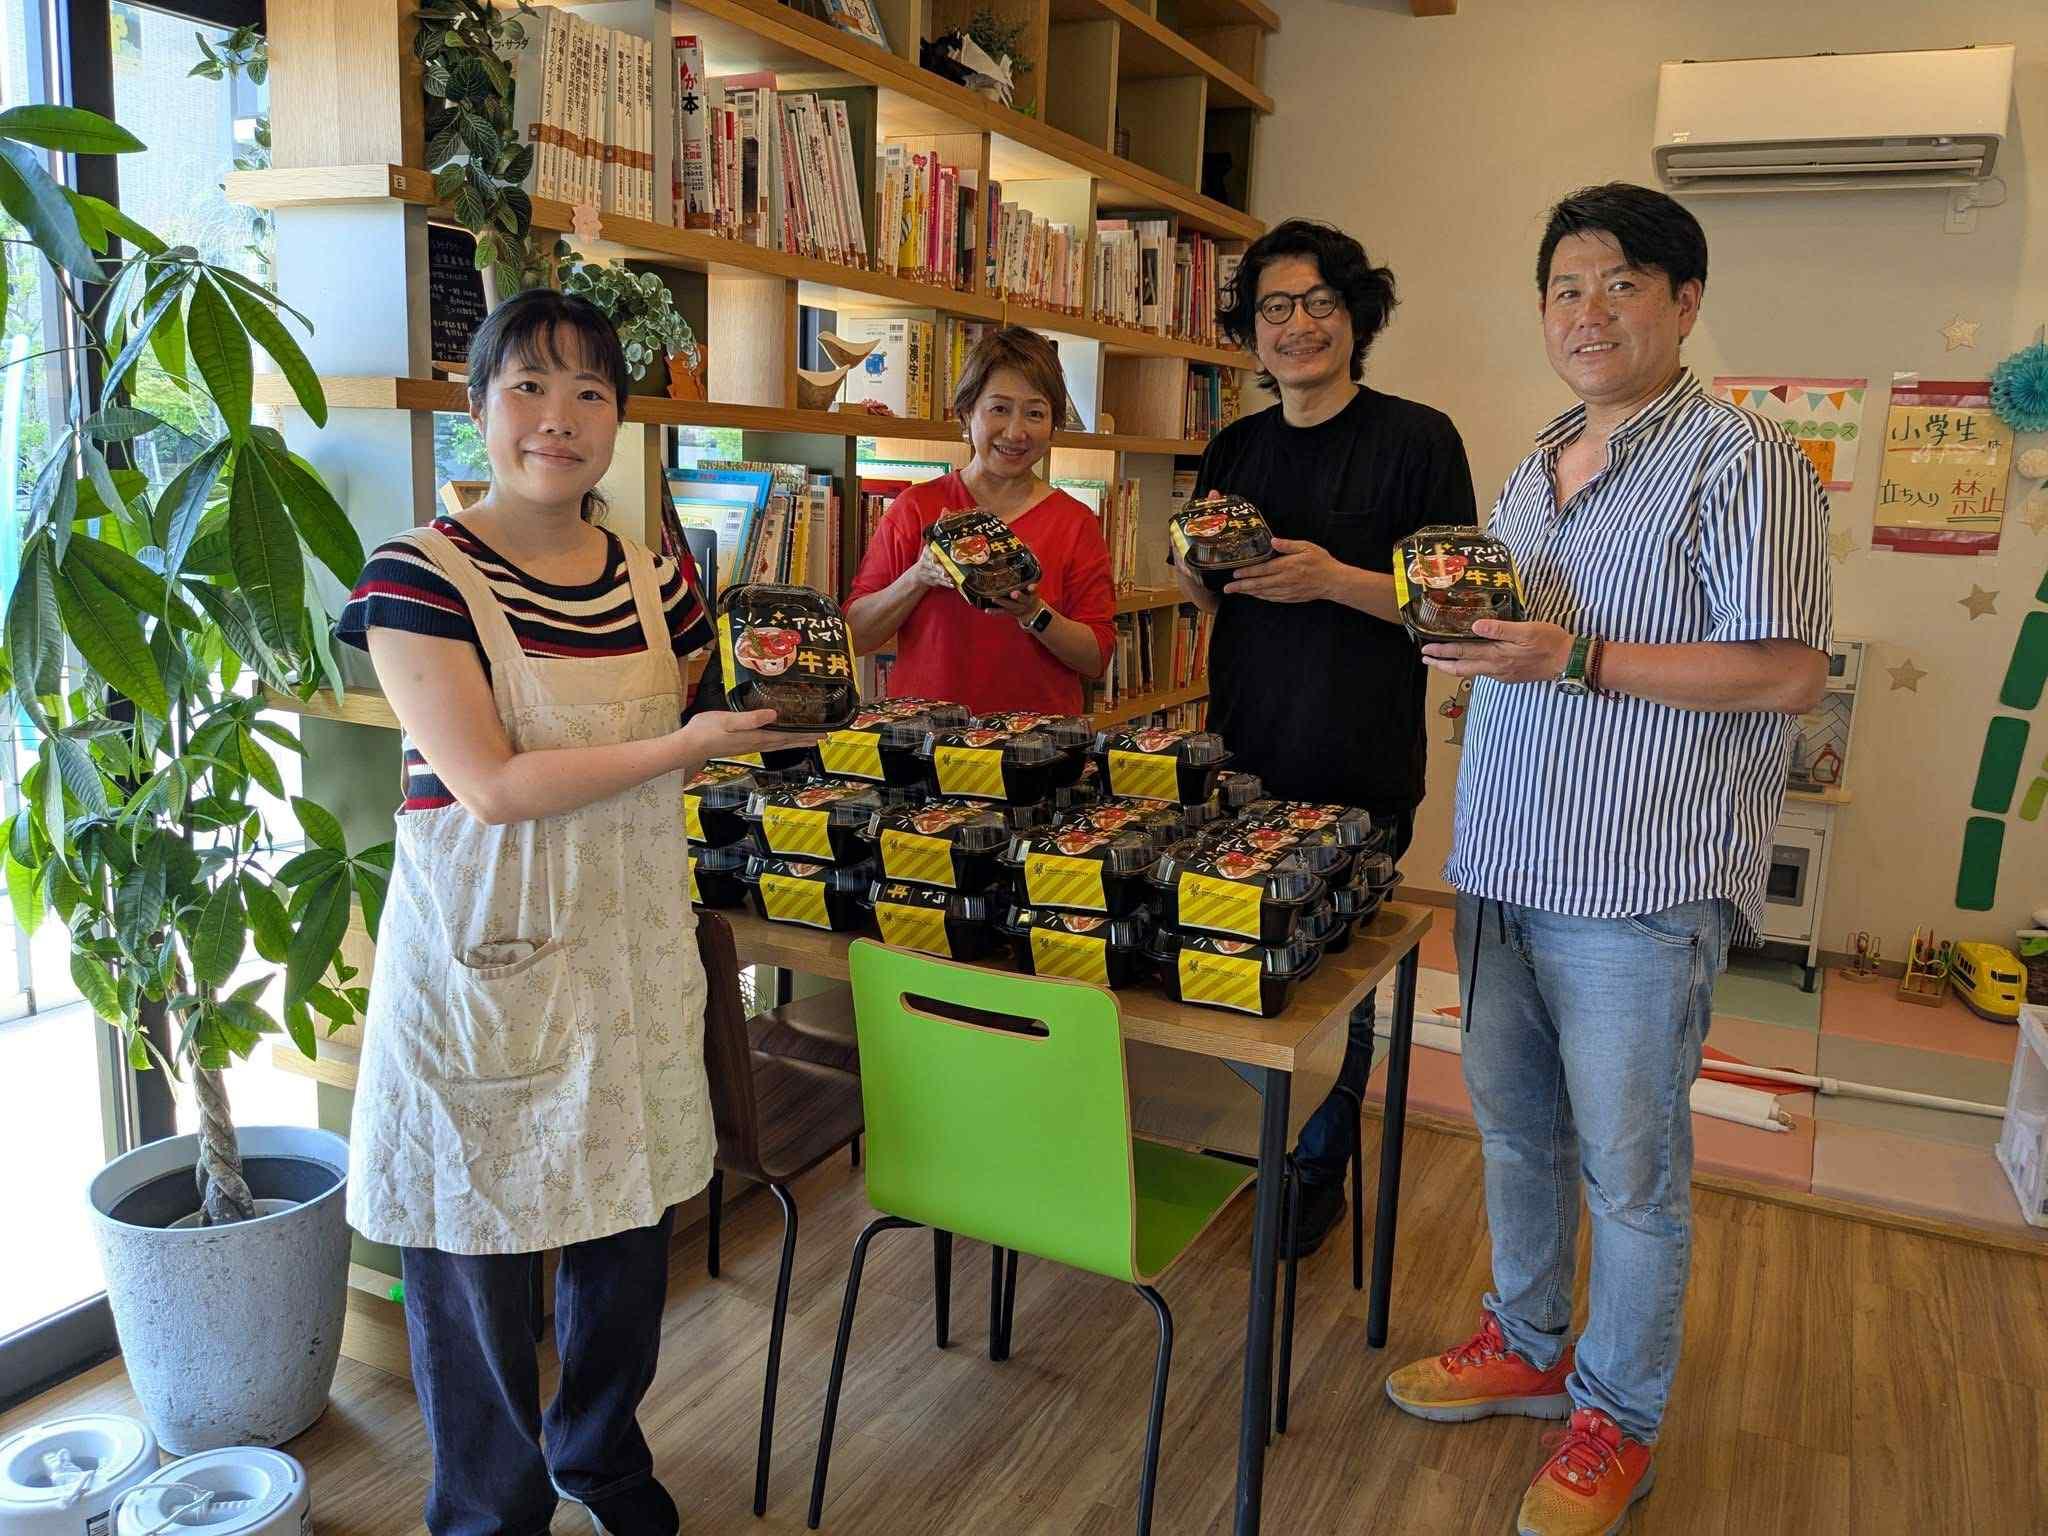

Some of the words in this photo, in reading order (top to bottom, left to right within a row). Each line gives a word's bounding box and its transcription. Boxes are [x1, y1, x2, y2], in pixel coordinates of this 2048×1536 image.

[1228, 517, 1264, 529] 牛丼
[990, 536, 1021, 553] 牛丼
[1459, 544, 1508, 556] アスパラ
[1474, 553, 1508, 563] トマト
[1464, 569, 1514, 589] 牛丼
[791, 616, 843, 631] アスパラ
[807, 629, 843, 642] トマト
[798, 650, 850, 676] 牛丼
